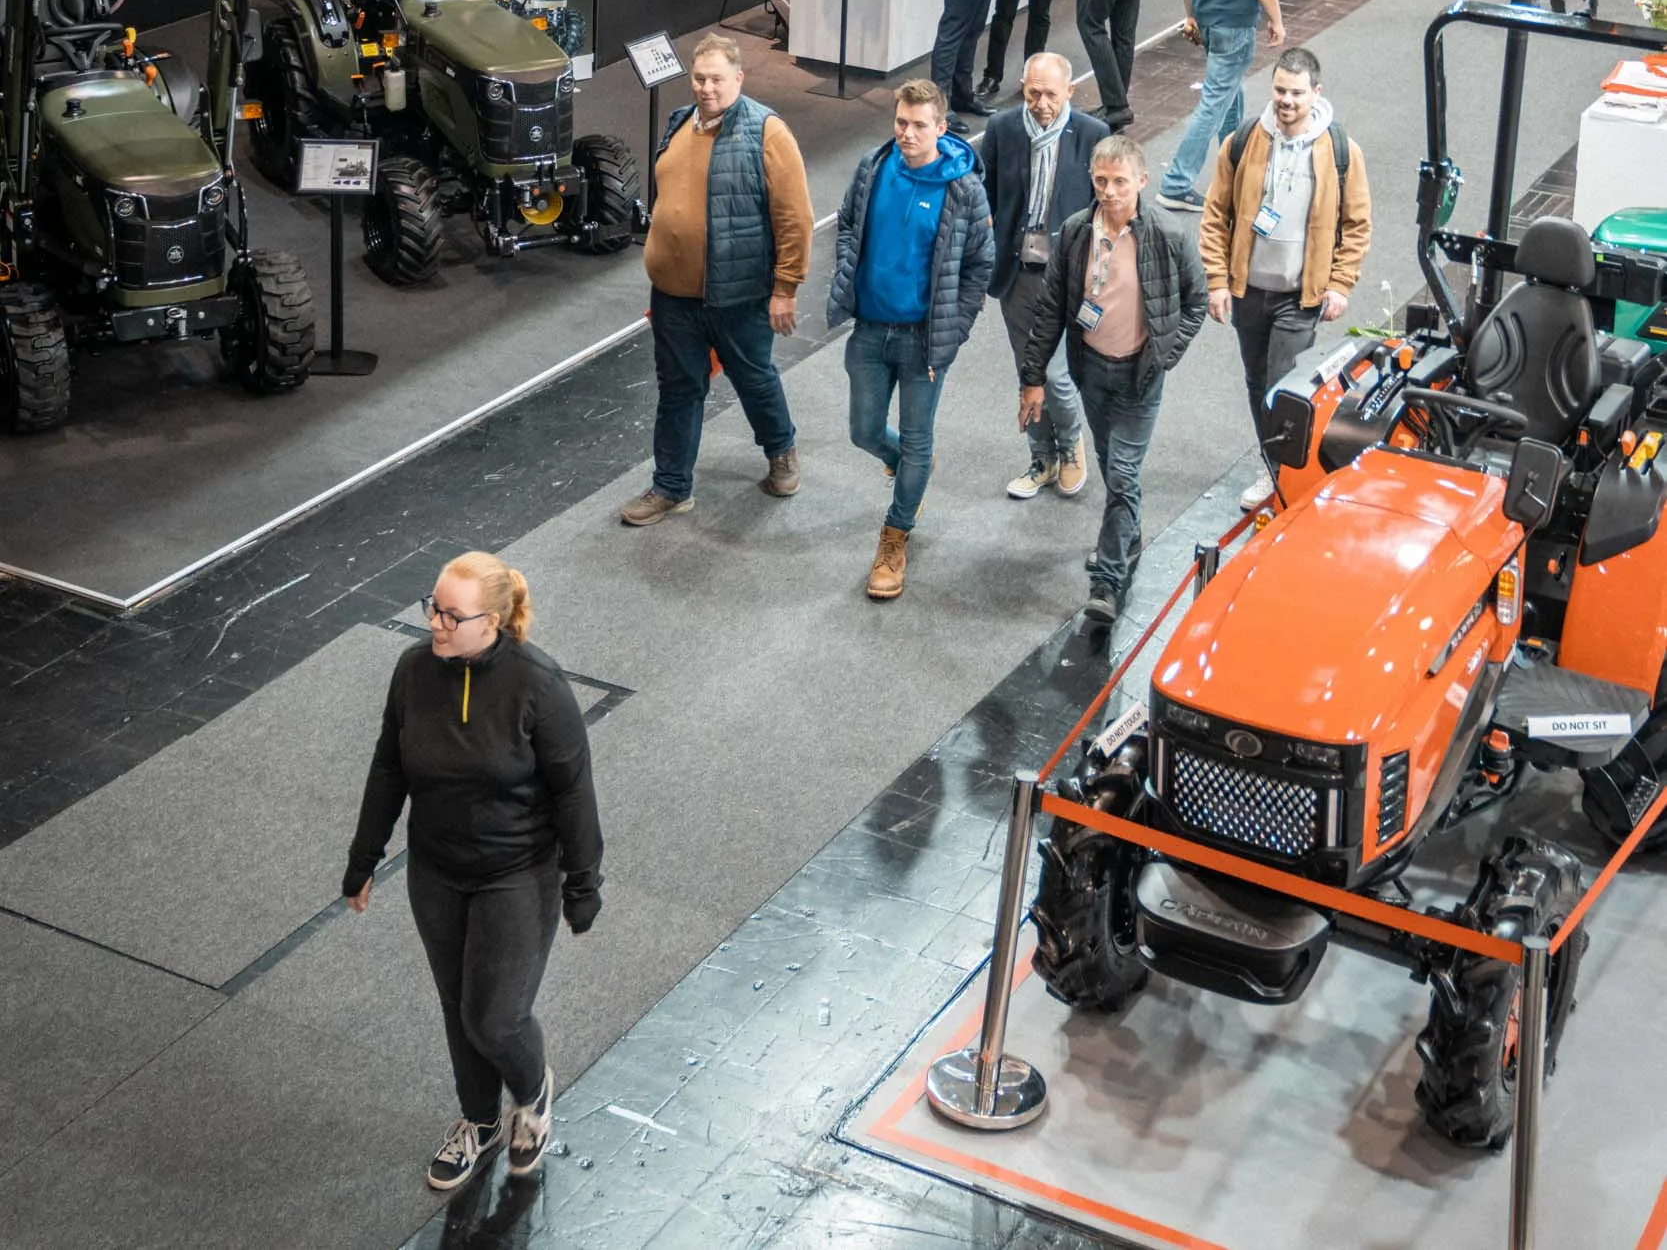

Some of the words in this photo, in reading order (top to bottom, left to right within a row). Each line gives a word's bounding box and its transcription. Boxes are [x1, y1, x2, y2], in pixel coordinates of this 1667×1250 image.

[1551, 721, 1568, 731] DO
[1569, 721, 1590, 730] NOT
[1592, 720, 1608, 730] SIT
[1106, 734, 1117, 747] DO
